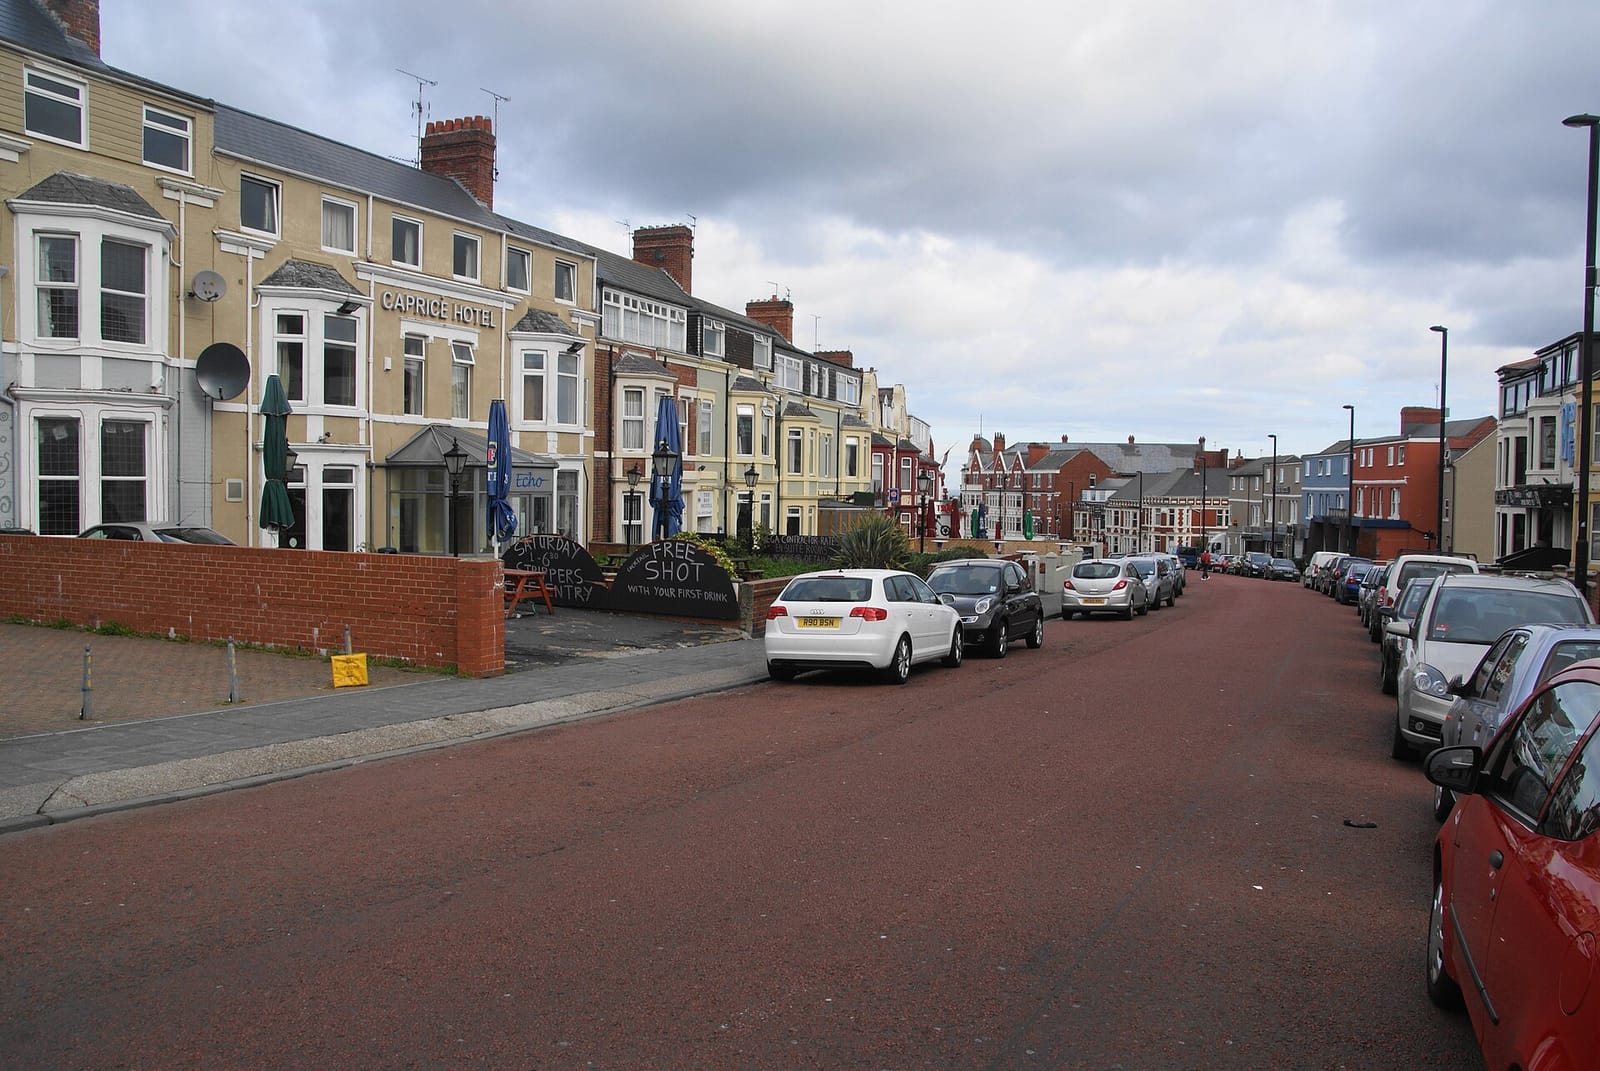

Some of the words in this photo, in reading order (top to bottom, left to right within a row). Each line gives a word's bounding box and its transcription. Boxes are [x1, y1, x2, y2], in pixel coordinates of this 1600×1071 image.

[382, 291, 449, 320] CAPRICE
[452, 303, 497, 329] HOTEL
[516, 472, 547, 488] Echo
[514, 536, 581, 560] SATURDAY
[651, 542, 696, 563] FREE
[645, 560, 704, 582] SHOT
[627, 584, 650, 596] WITH
[654, 586, 677, 598] YOUR
[677, 588, 702, 599] FIRST
[704, 591, 728, 603] DRINK
